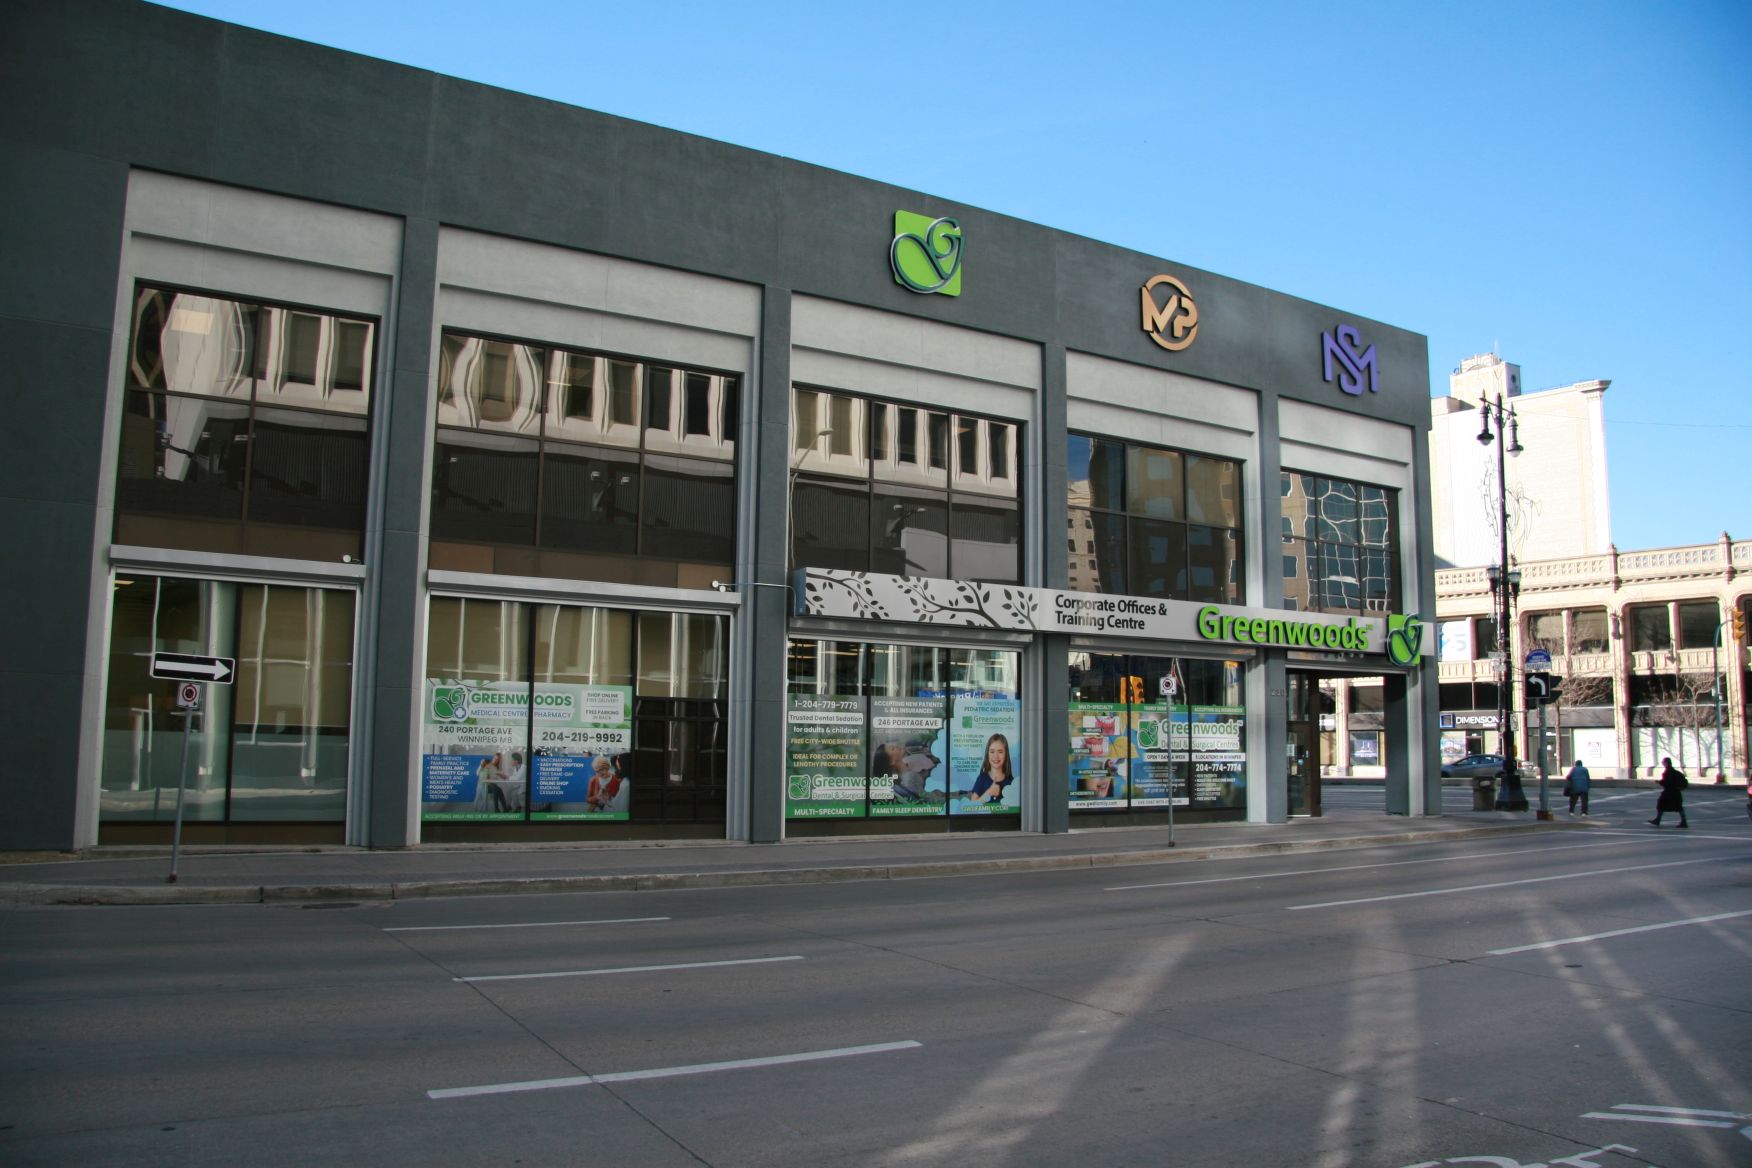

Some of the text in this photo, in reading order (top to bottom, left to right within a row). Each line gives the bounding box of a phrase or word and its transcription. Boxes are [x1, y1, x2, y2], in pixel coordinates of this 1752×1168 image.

[1055, 594, 1167, 616] Corporate Offices &
[1054, 610, 1145, 630] Training Centre
[1198, 604, 1369, 650] Greenwoods
[471, 692, 572, 706] GREENWOODS
[794, 700, 858, 709] 1-204-779-7779
[471, 709, 572, 719] MEDICAL CENTRE PHARMACY
[974, 715, 1014, 723] Greenwoods
[878, 718, 891, 726] 246
[438, 725, 513, 735] 240 PORTAGE AVE
[1161, 720, 1238, 735] Greenwoods
[457, 735, 513, 744] WINNIPEG MB
[542, 731, 623, 743] 204-219-9992
[1192, 740, 1216, 750] Surgical
[1216, 740, 1239, 748] Centres
[1195, 763, 1242, 772] 204-774-7774
[813, 775, 893, 787] Greenwoods
[841, 792, 865, 800] Surgical
[794, 807, 855, 816] MULTI-SPECIALTY
